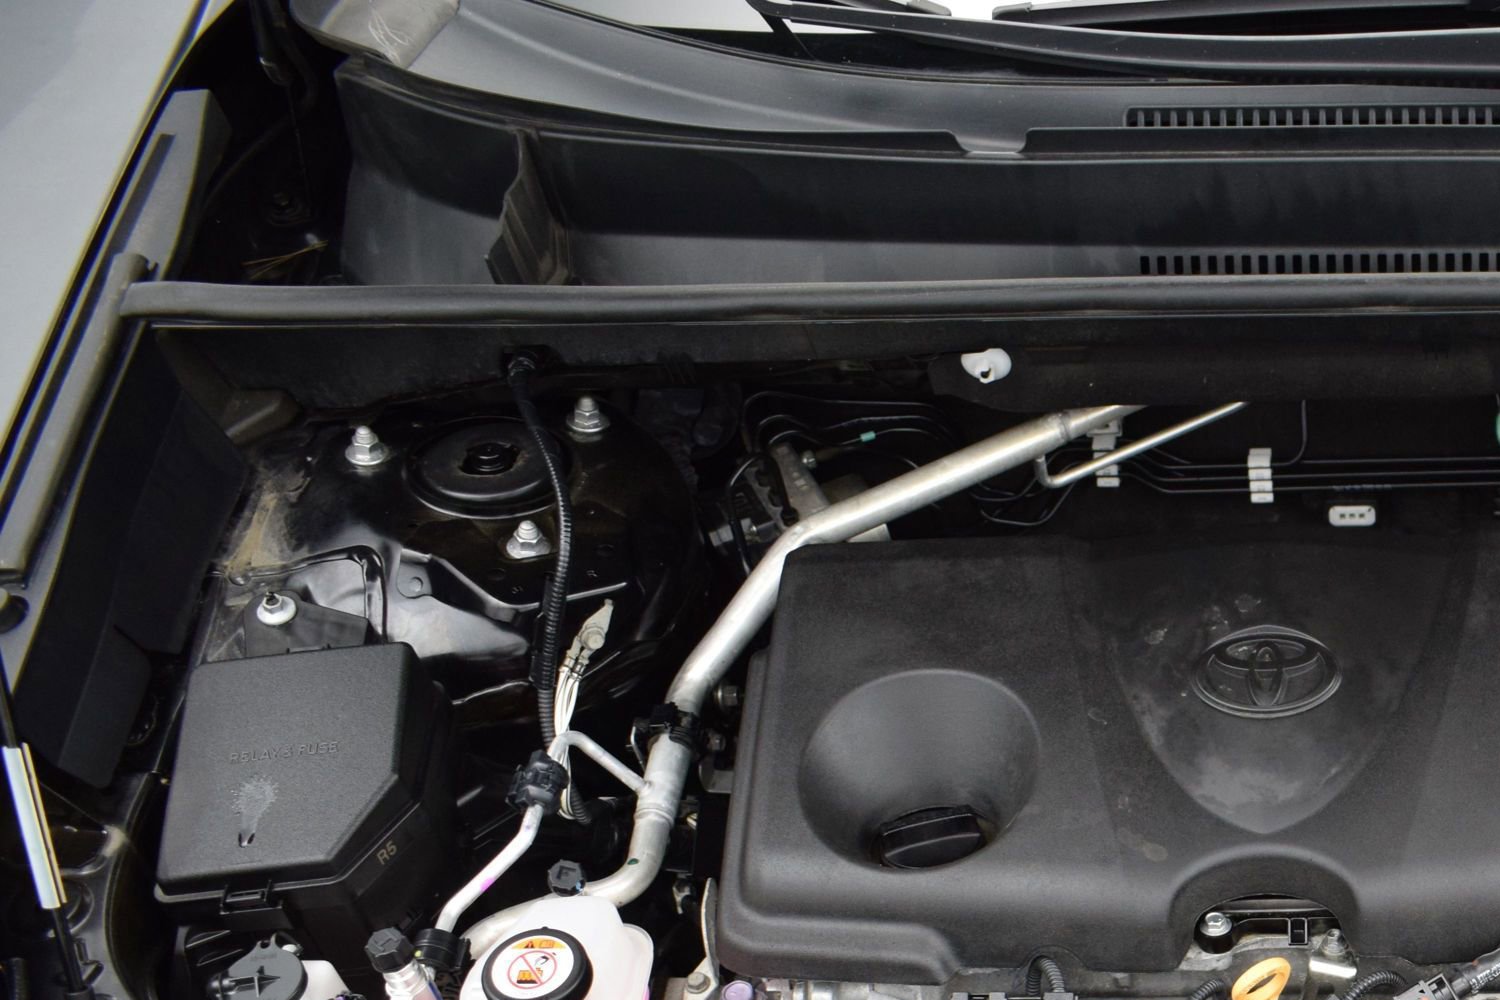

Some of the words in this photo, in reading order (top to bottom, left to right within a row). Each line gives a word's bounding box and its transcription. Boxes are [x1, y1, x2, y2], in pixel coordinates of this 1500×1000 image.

[230, 749, 279, 764] RELAY
[299, 741, 340, 756] FUSE
[376, 840, 398, 865] R5
